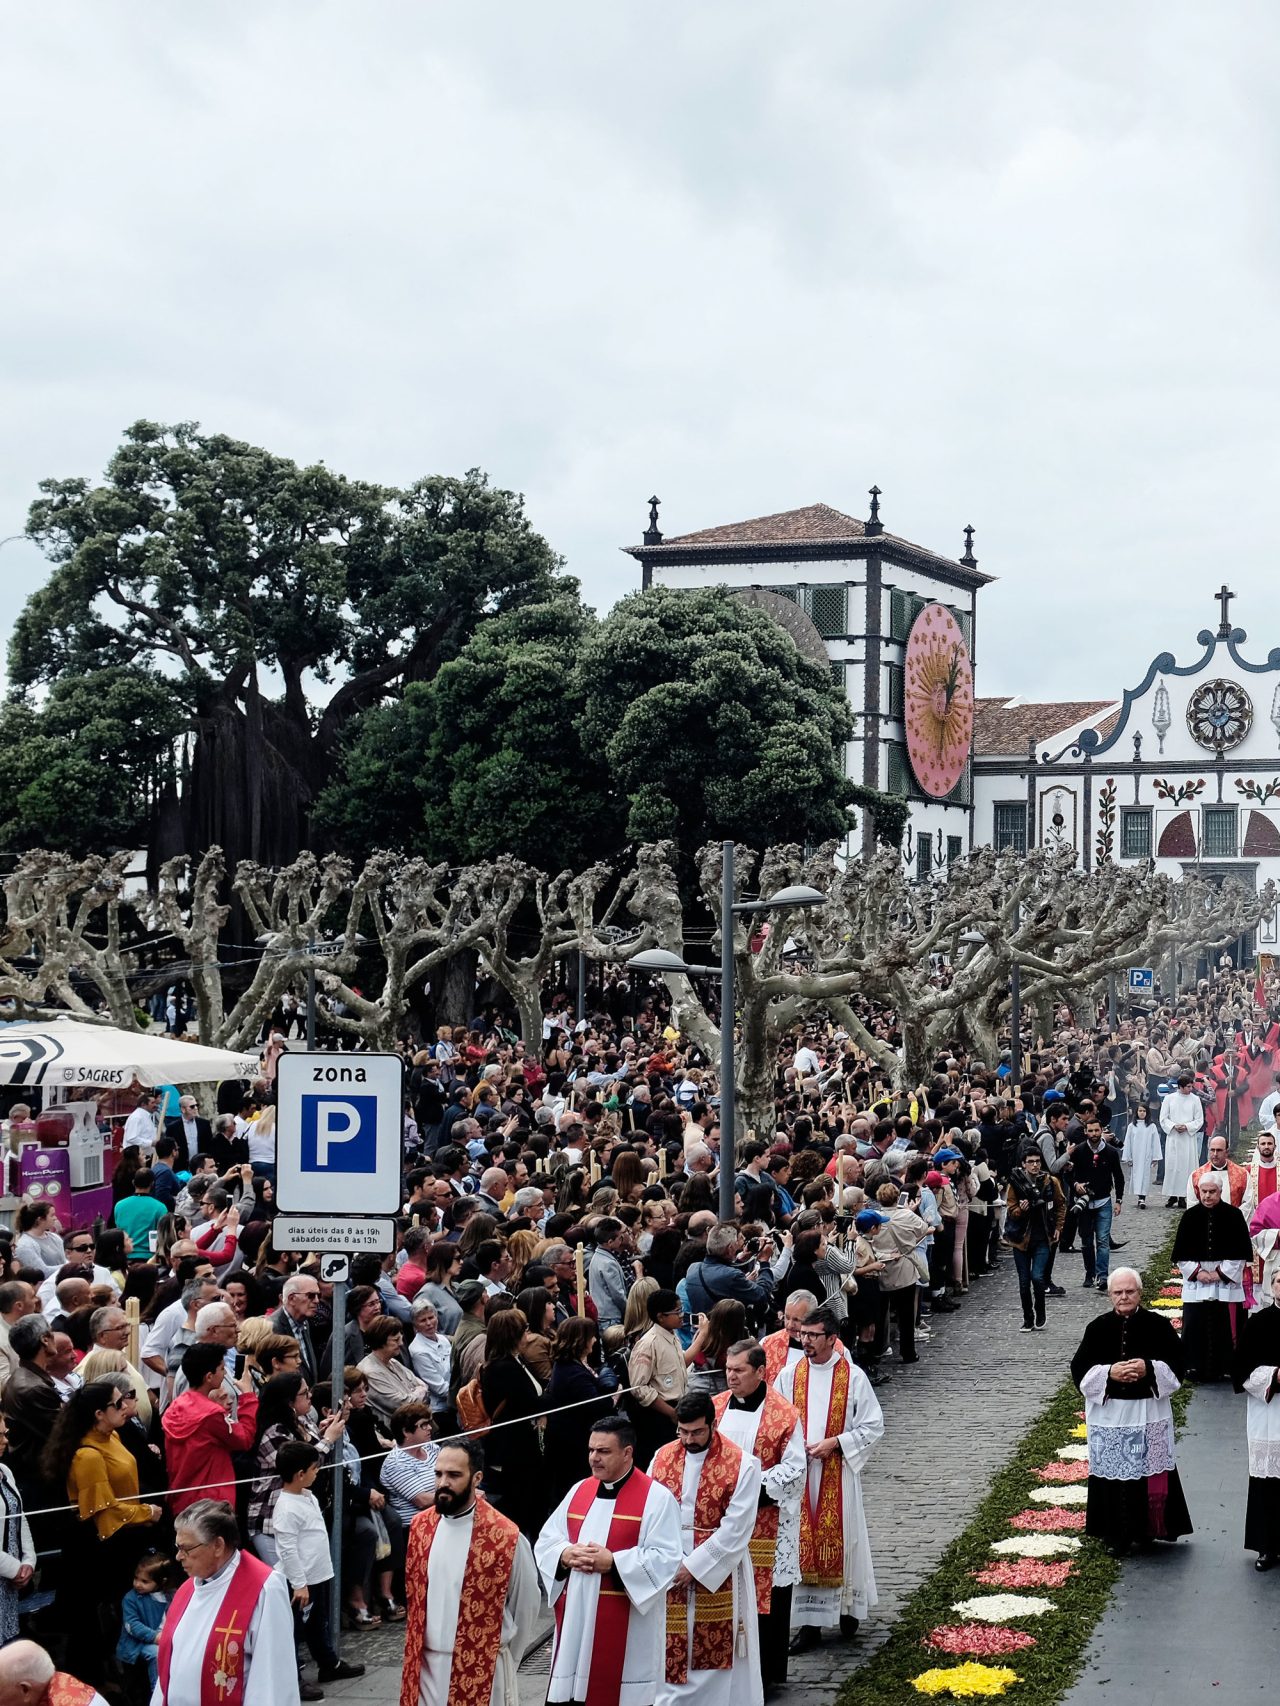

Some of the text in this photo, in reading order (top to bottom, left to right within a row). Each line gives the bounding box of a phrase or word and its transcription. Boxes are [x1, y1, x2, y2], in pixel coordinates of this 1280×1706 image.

[1133, 971, 1144, 986] P
[77, 1067, 124, 1083] SAGRES
[313, 1067, 367, 1083] zona
[316, 1101, 362, 1166] P
[288, 1226, 305, 1234] dias
[308, 1226, 328, 1234] úteis
[347, 1227, 353, 1235] 8
[355, 1227, 364, 1235] às
[291, 1235, 325, 1243] sábados
[352, 1236, 361, 1244] às
[363, 1236, 377, 1244] 13h
